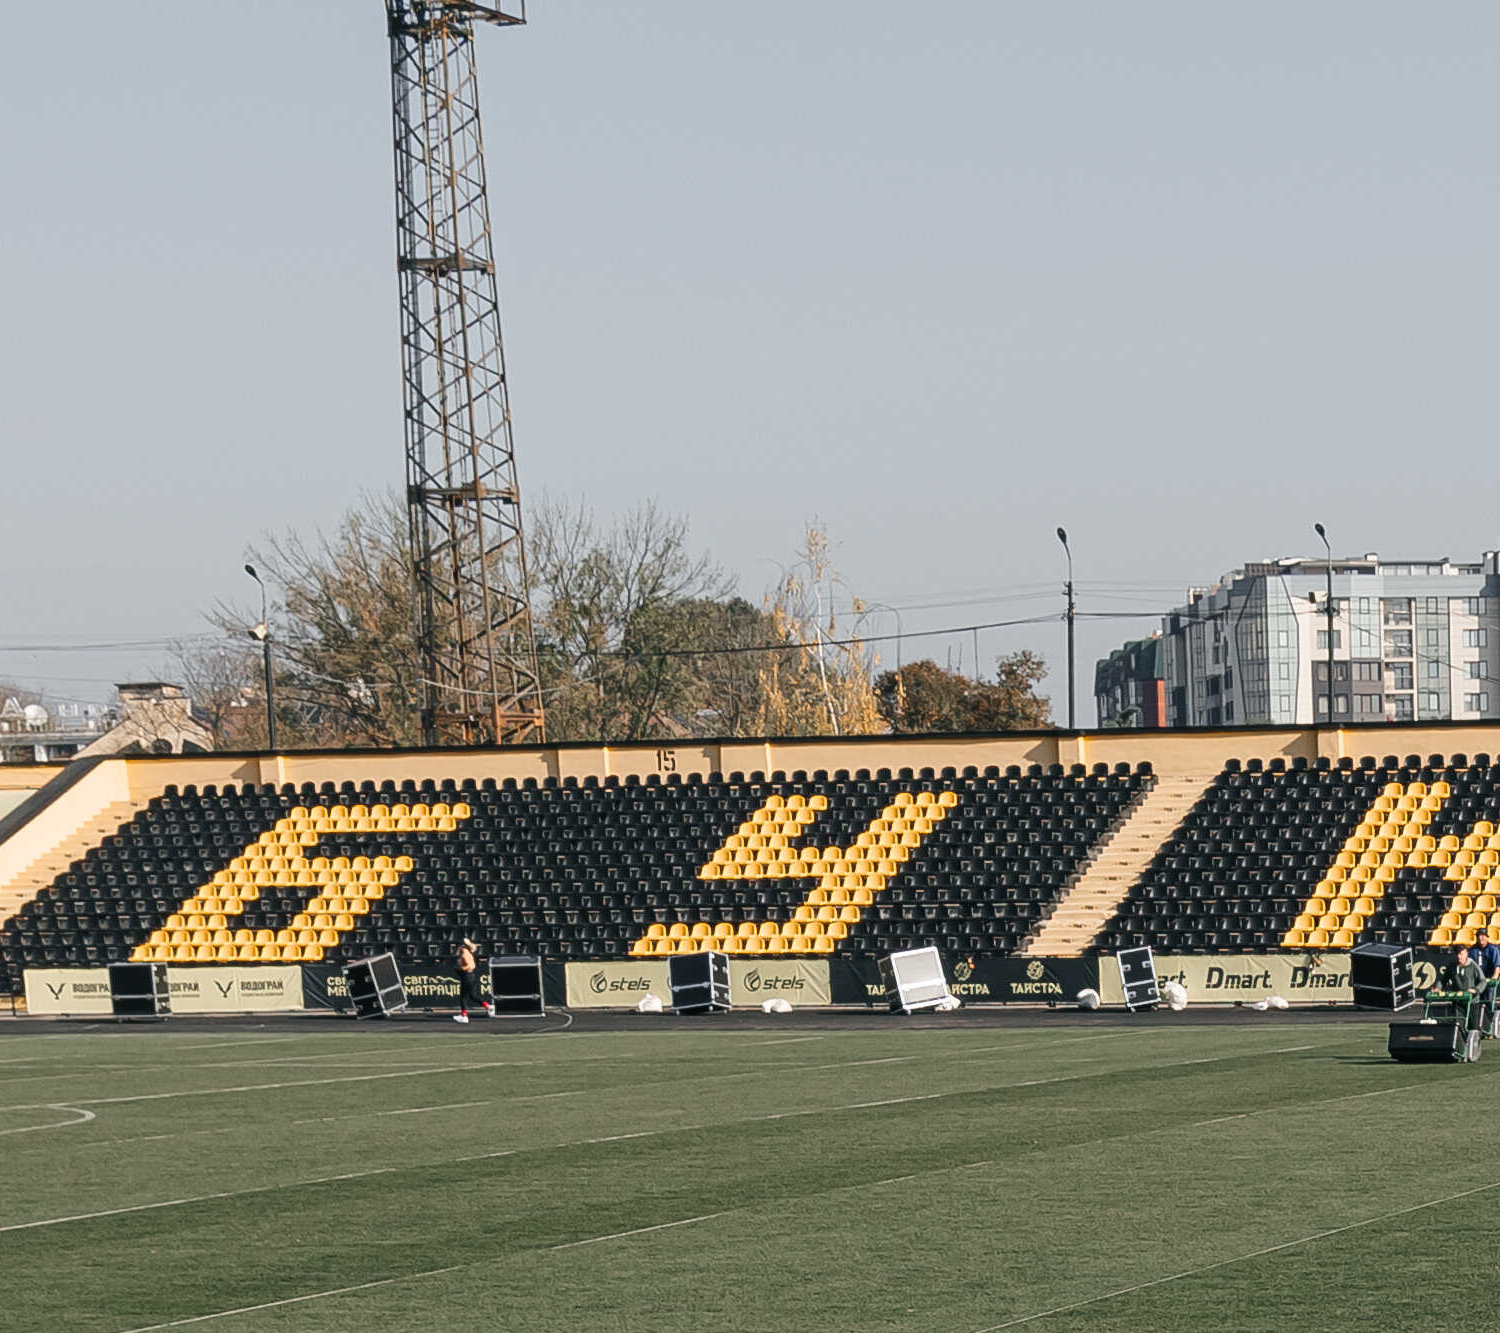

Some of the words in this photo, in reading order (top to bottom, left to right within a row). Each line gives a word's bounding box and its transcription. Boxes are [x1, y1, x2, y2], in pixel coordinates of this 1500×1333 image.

[657, 750, 676, 771] 15
[404, 976, 429, 986] СВІТ
[609, 976, 651, 992] stels
[763, 976, 806, 992] stels
[1289, 966, 1352, 989] Dmar
[72, 983, 110, 993] ВОДОГРА
[240, 981, 284, 991] ВОДОГРАЙ
[946, 983, 991, 996] АЙСТРА
